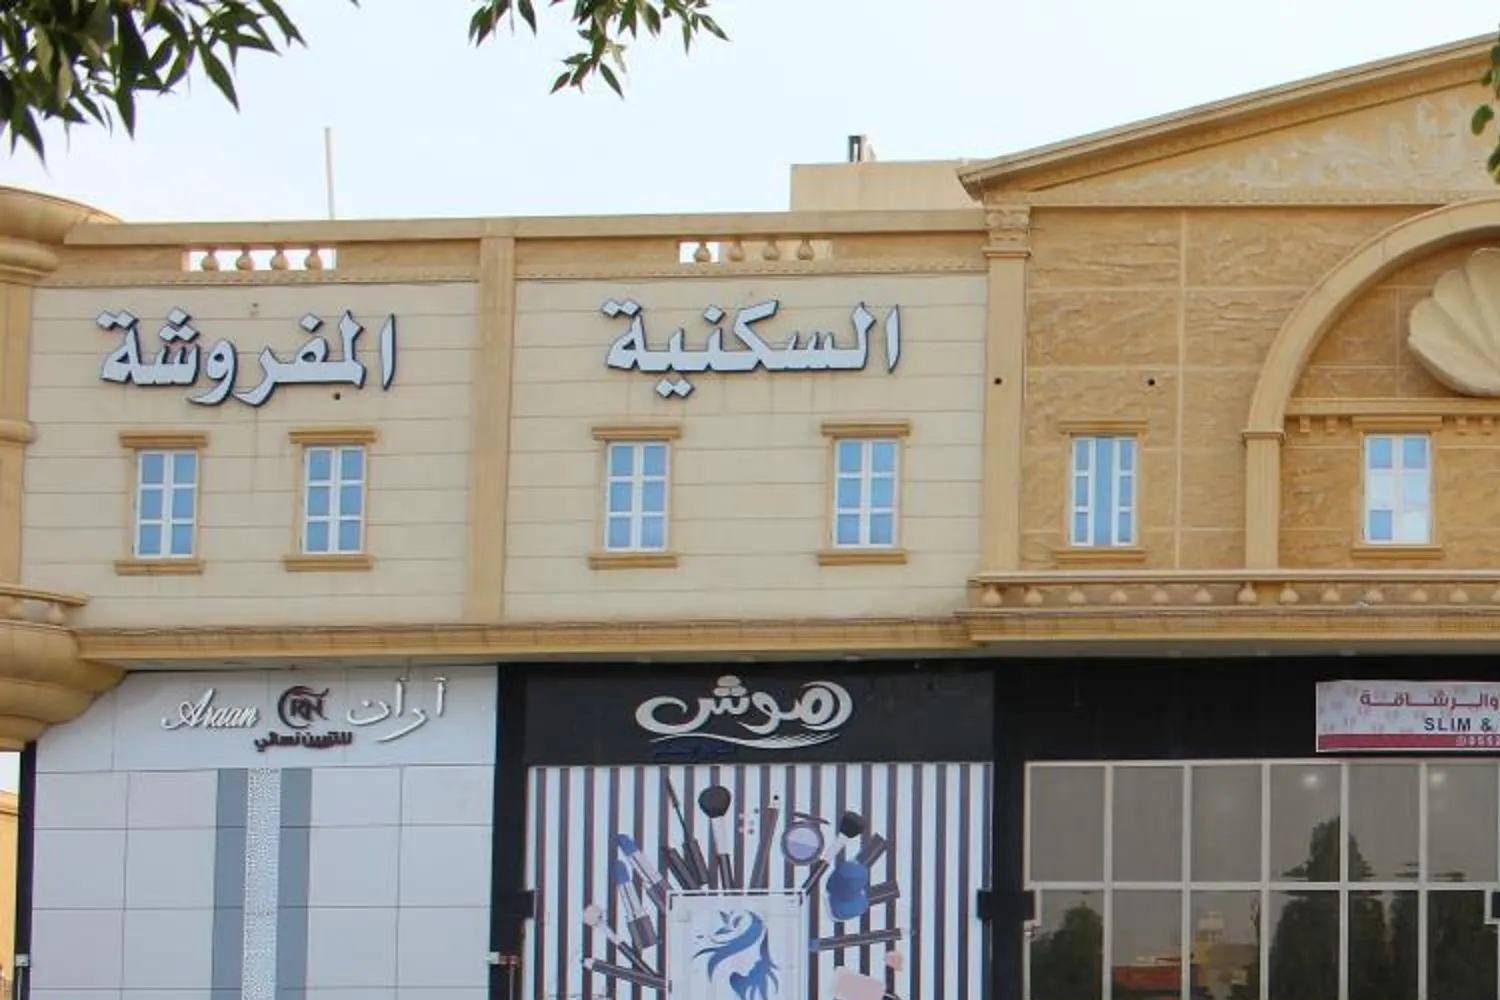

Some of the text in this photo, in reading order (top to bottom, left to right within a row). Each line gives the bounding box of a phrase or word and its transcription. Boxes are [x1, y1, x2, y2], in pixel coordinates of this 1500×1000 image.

[96, 306, 397, 407] المفروشة
[601, 299, 901, 398] السكنية
[161, 688, 258, 730] Araan
[1424, 717, 1471, 732] SLIM
[1480, 717, 1493, 732] &
